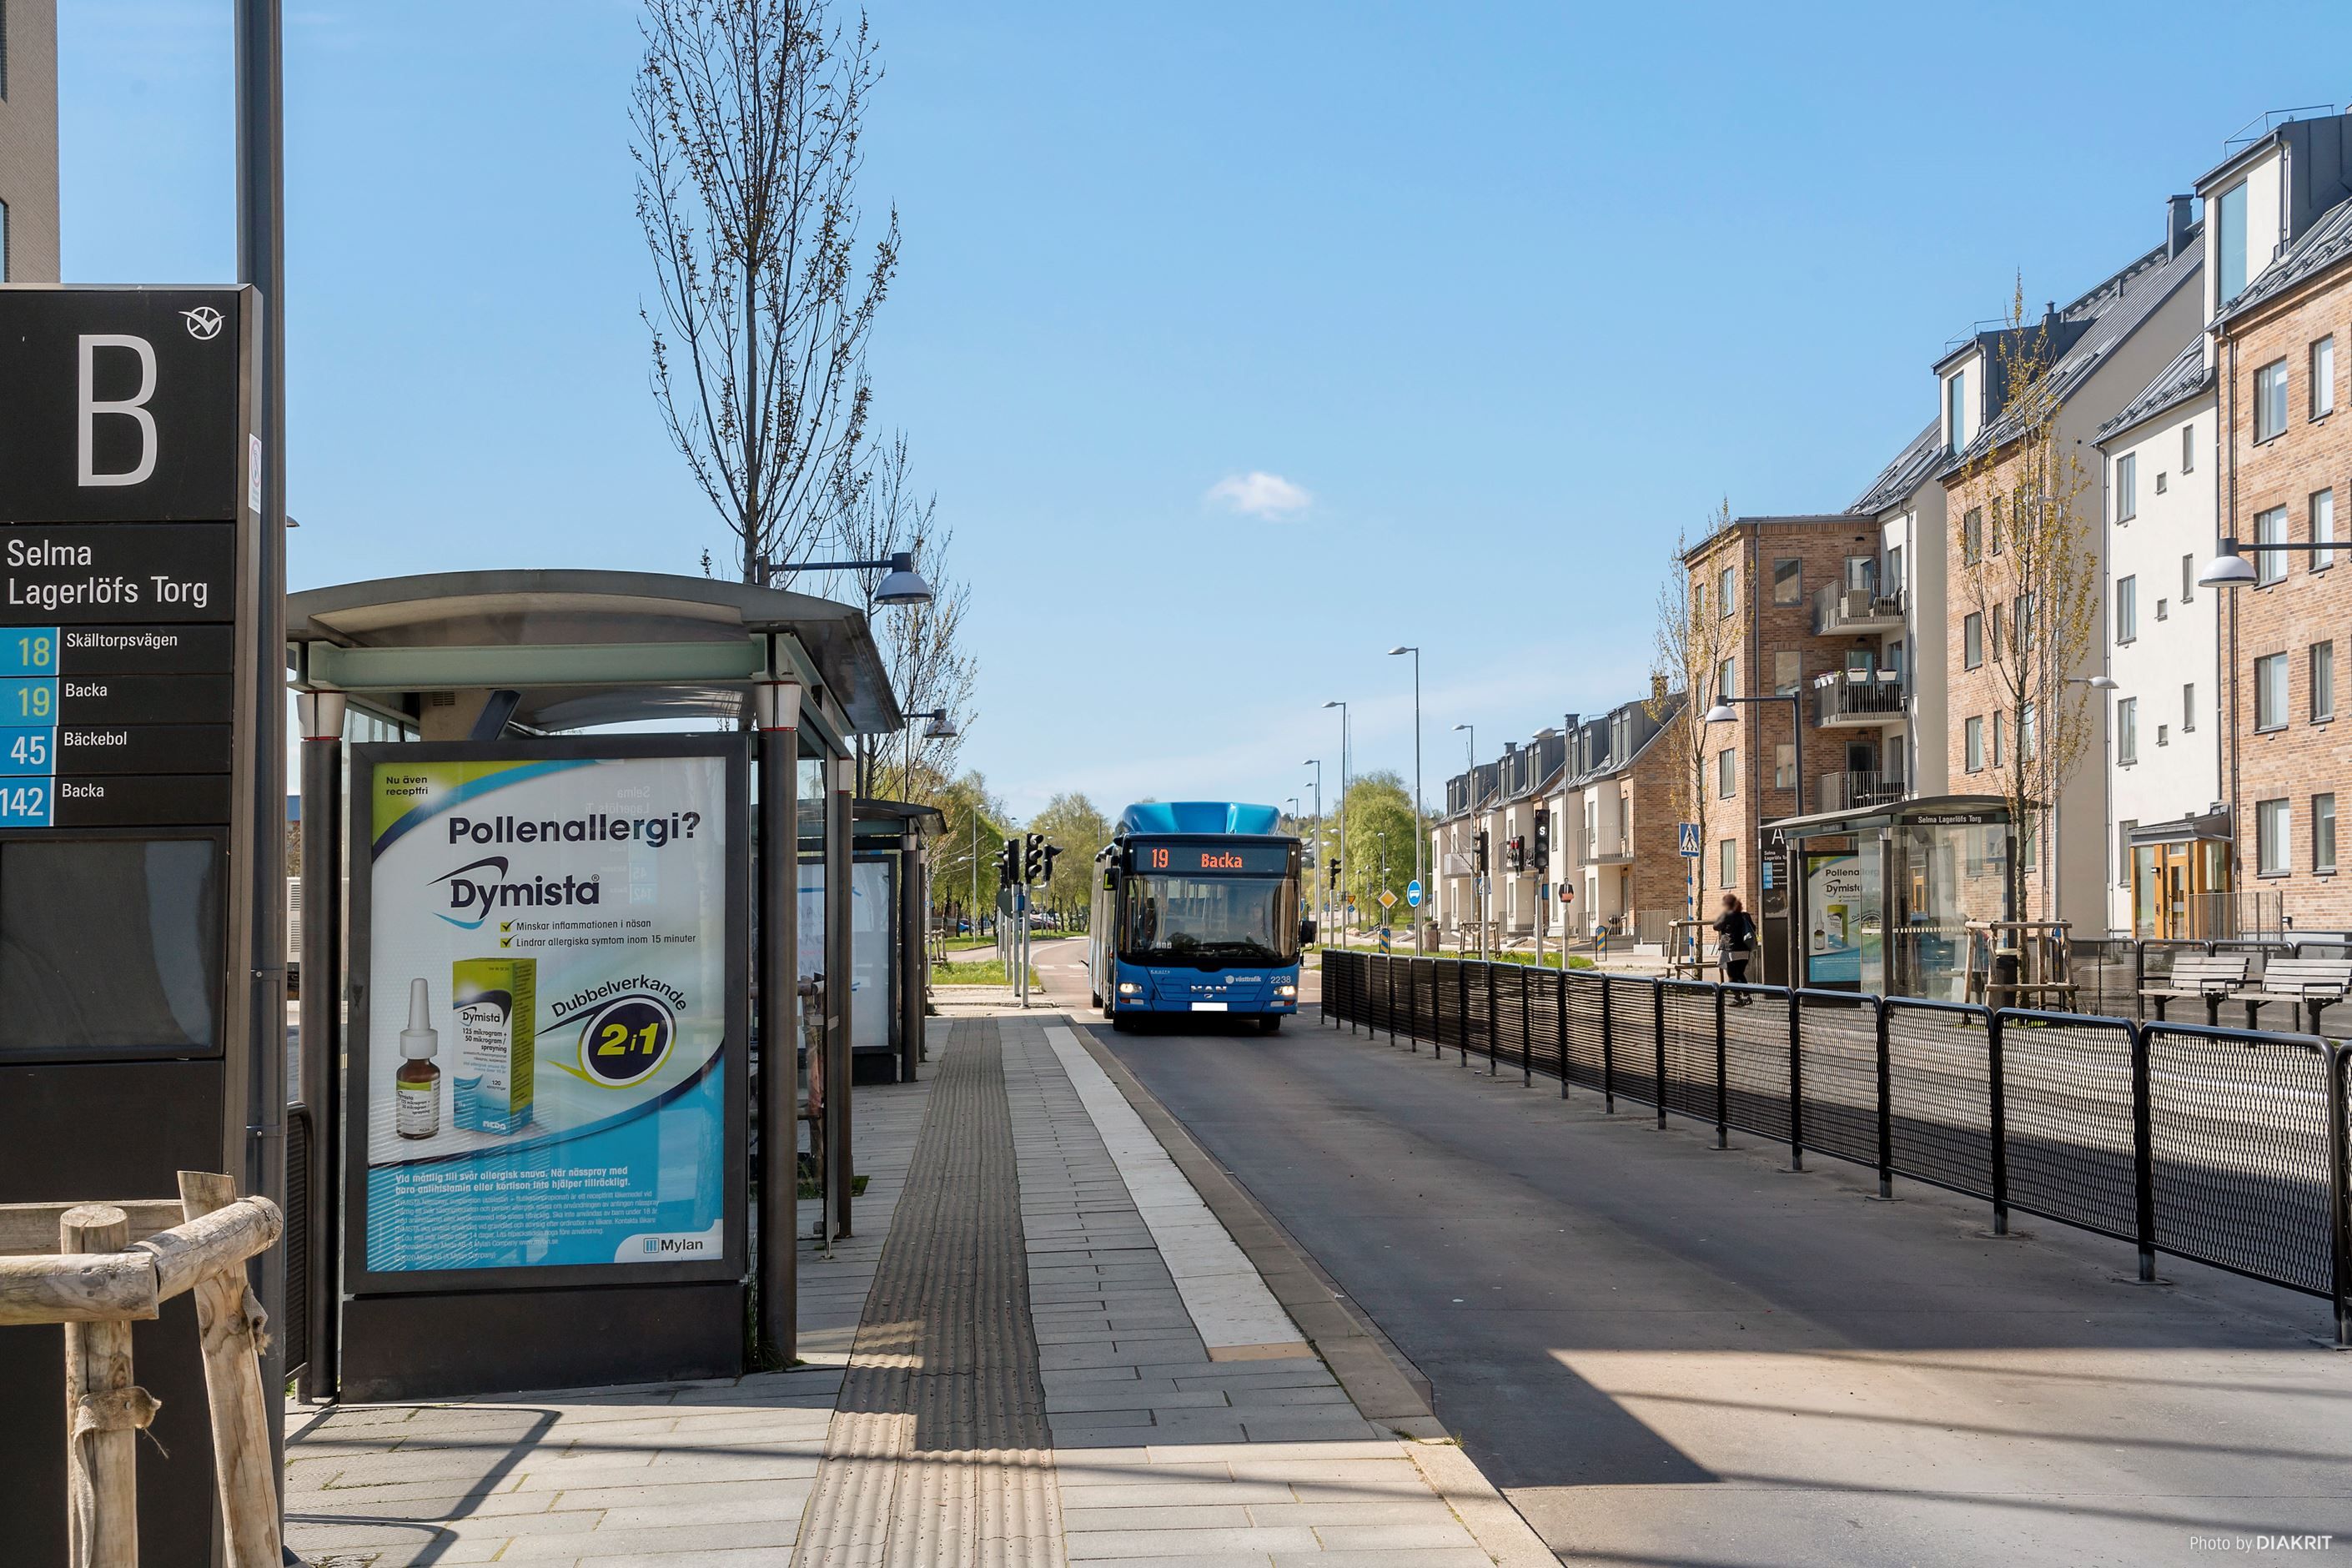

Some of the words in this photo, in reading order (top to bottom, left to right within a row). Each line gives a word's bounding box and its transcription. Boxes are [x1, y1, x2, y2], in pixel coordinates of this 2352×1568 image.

[78, 334, 158, 486] B
[7, 539, 93, 567] Selma
[9, 576, 138, 611] Lagerlöfs
[151, 575, 208, 608] Torg
[67, 632, 178, 651] Skälltorpsvägen
[18, 637, 50, 666] 18
[65, 683, 108, 697] Backa
[18, 687, 50, 716] 19
[64, 731, 128, 746] Bäckebol
[10, 736, 46, 766] 45
[403, 775, 428, 784] även
[62, 784, 104, 797] Backa
[386, 787, 428, 797] receptfri
[0, 787, 44, 817] 142
[1917, 816, 1937, 824] Selma
[1938, 815, 1967, 824] Lagerlöfs
[1968, 815, 1982, 824] Torg
[449, 812, 701, 847] Pollenallergi?
[1772, 828, 1785, 845] A
[1152, 848, 1168, 868] 19
[1201, 852, 1243, 868] Backa
[516, 922, 549, 932] Minskar
[552, 921, 618, 930] inflammationen
[516, 937, 545, 947] Lindrar
[548, 937, 589, 947] allergiska
[591, 936, 624, 947] symtom
[627, 935, 648, 944] inom
[651, 934, 661, 943] 15
[664, 934, 696, 943] minuter
[1270, 976, 1291, 984] 2238
[551, 974, 686, 1018] Dubbelverkande
[1191, 985, 1228, 993] MAN
[462, 1012, 500, 1025] Dymista
[473, 1028, 502, 1038] mikrogram
[473, 1036, 502, 1044] mikrogram
[481, 1044, 507, 1053] sprayning
[395, 1174, 410, 1184] Vid
[413, 1173, 443, 1183] måttlig
[445, 1171, 457, 1181] till
[460, 1171, 478, 1181] svår
[480, 1170, 518, 1181] allergisk
[520, 1169, 548, 1178] snuva.
[551, 1168, 565, 1178] När
[569, 1168, 606, 1179] nässpray
[609, 1167, 628, 1175] med
[395, 1184, 415, 1194] bara
[418, 1184, 471, 1193] antihistamin
[474, 1183, 493, 1191] eller
[495, 1182, 530, 1191] kortison
[552, 1179, 582, 1189] hjälper
[585, 1178, 631, 1188] tillräckligt.
[661, 1239, 703, 1254] Mylan
